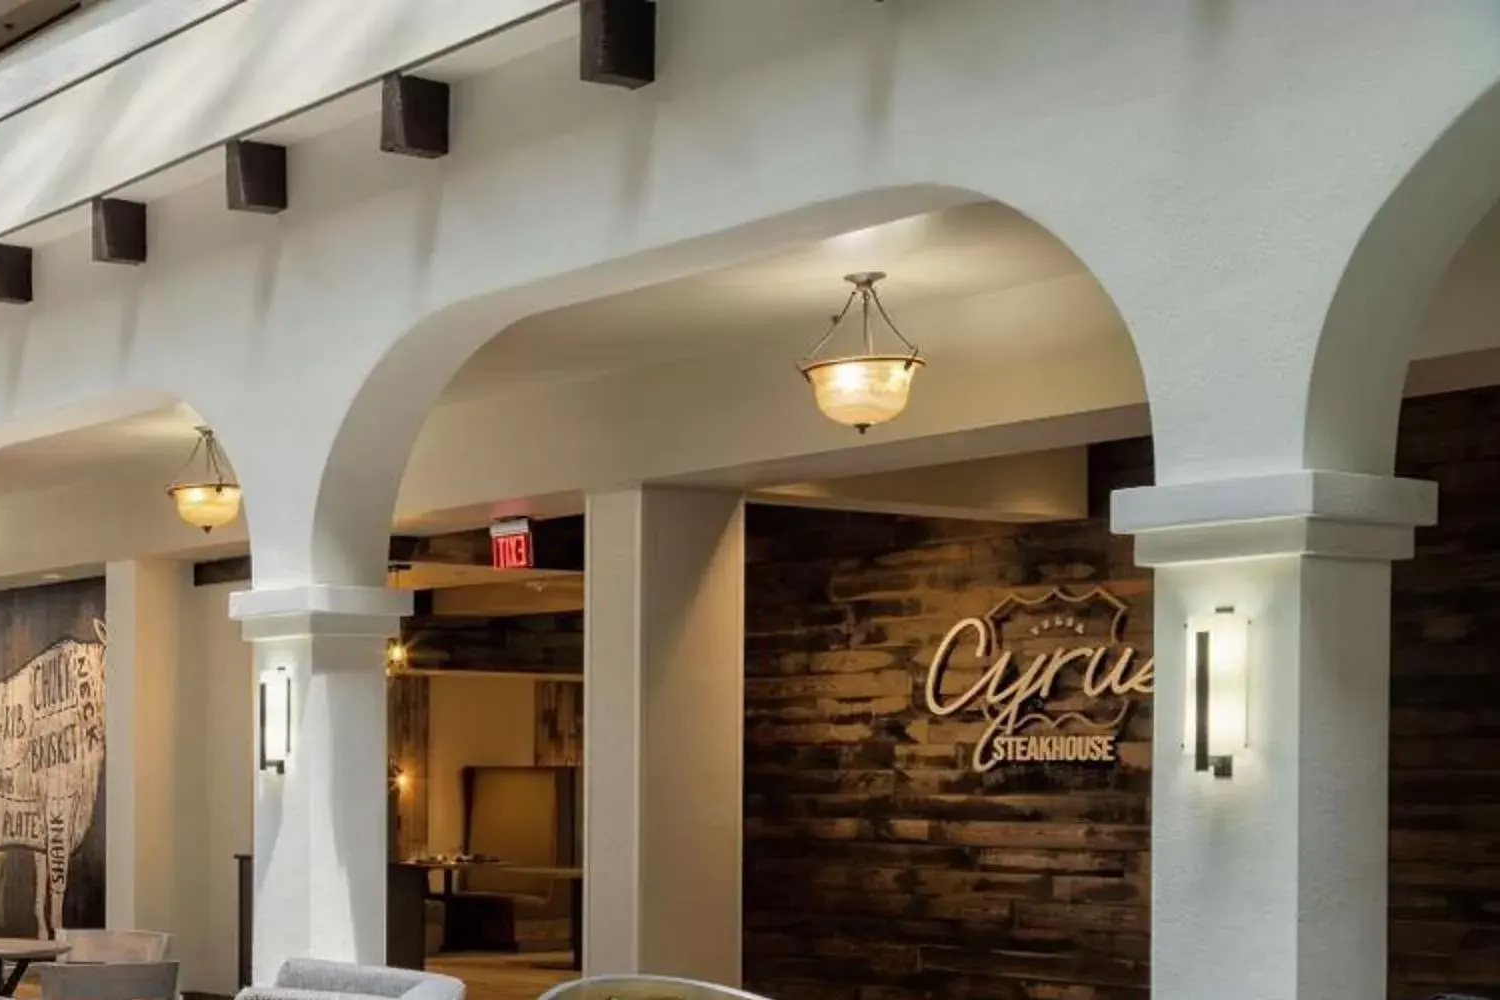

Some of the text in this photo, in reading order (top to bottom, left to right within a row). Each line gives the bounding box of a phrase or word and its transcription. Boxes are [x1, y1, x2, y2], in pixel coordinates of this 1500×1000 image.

[3, 703, 27, 741] RIB
[77, 656, 99, 753] NECK
[30, 723, 77, 774] BRISKET
[992, 734, 1117, 762] STEAKHOUSE
[2, 810, 39, 839] PLATE
[48, 810, 65, 885] SHANK
